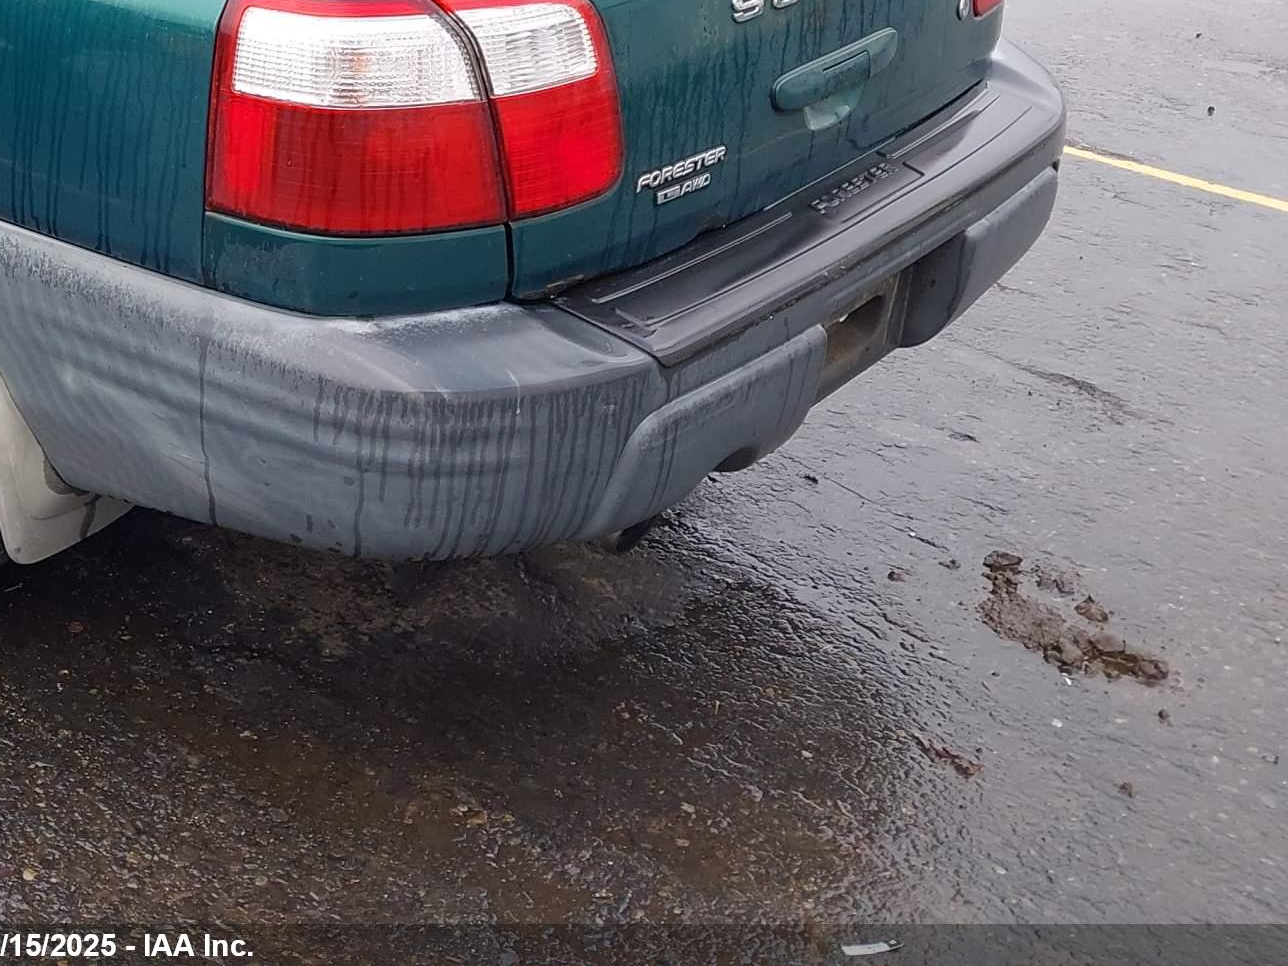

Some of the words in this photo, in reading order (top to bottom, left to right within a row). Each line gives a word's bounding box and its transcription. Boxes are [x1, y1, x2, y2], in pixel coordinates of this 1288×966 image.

[636, 145, 727, 194] FORESTER
[680, 173, 711, 196] AWD
[810, 162, 899, 215] FORESTER
